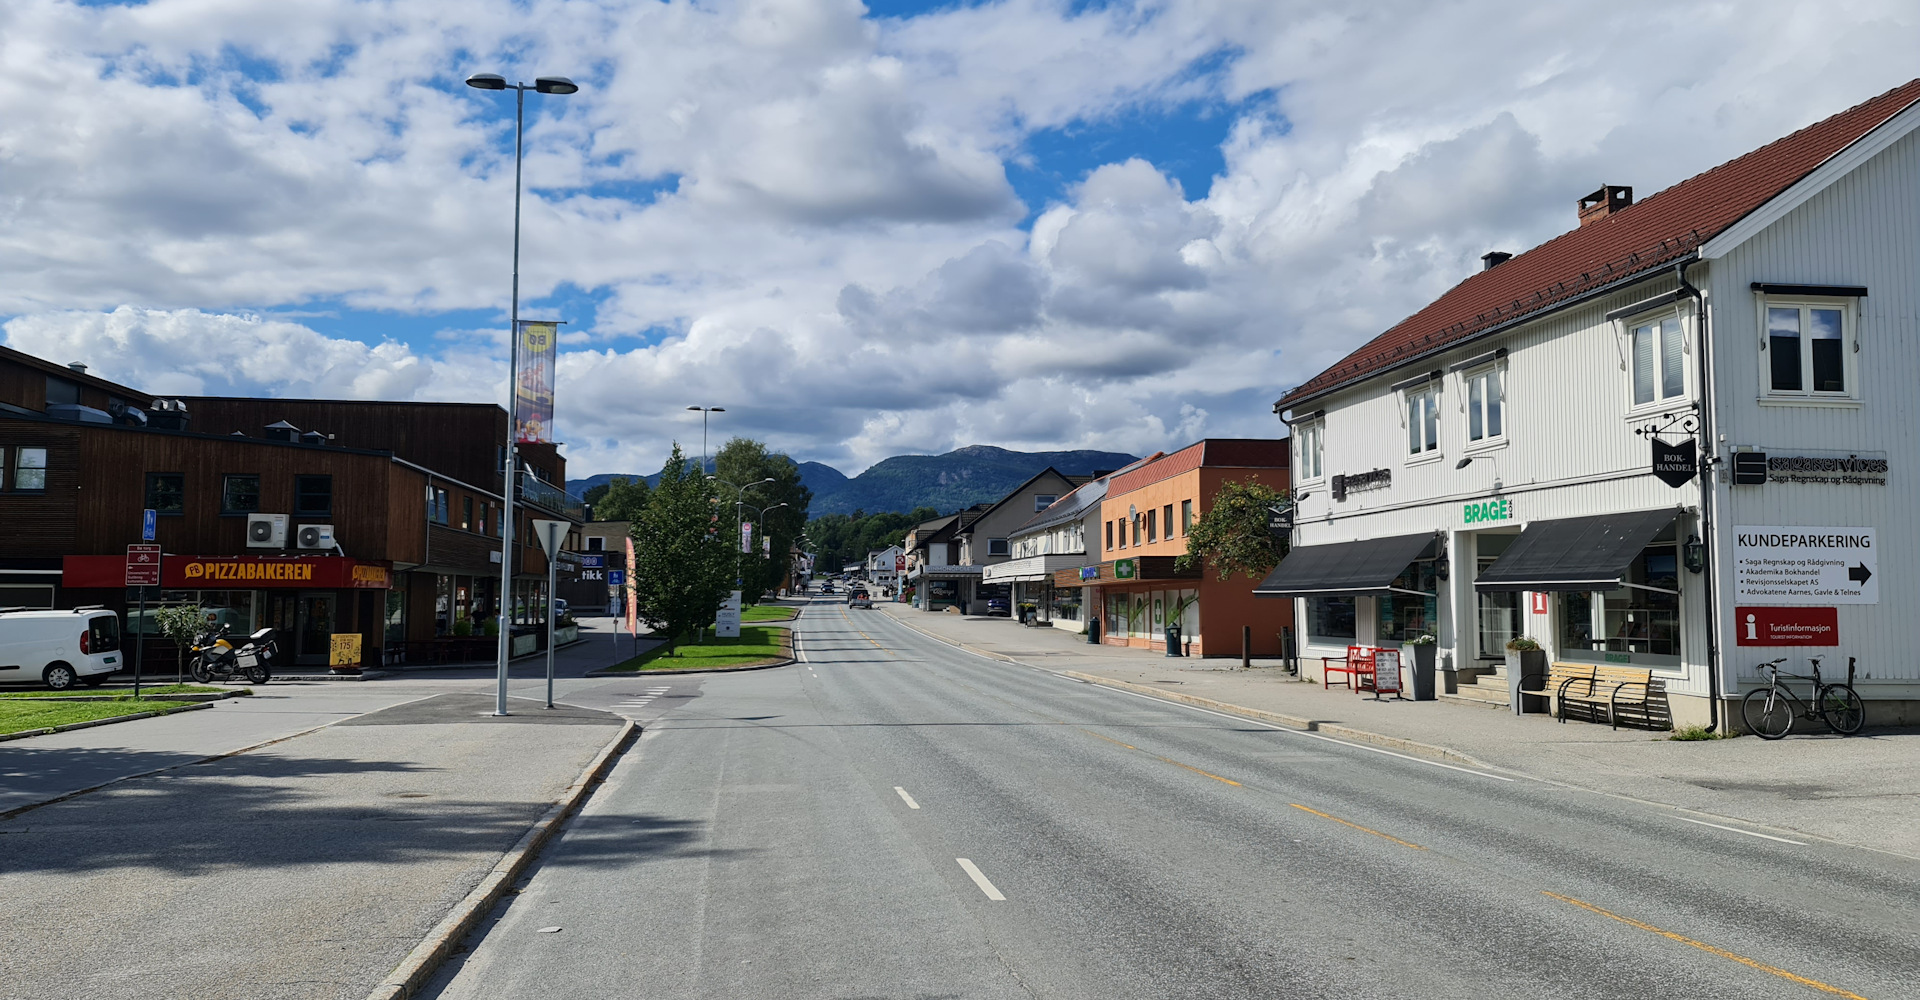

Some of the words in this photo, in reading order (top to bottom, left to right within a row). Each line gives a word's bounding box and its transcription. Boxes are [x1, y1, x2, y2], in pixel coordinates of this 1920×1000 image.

[1663, 454, 1687, 463] BOK-
[1769, 455, 1889, 473] sagaservices
[1656, 463, 1694, 472] HANDEL
[1769, 474, 1789, 483] Saga
[1791, 475, 1829, 485] Regnskap
[1831, 477, 1841, 485] og
[1463, 500, 1508, 523] BRAGE
[1738, 534, 1871, 548] KUNDEPARKERING
[1807, 559, 1845, 567] Rådgivning
[205, 563, 312, 580] PIZZABAKEREN
[582, 570, 603, 581] tikk
[1769, 623, 1831, 634] Turistinformasjon
